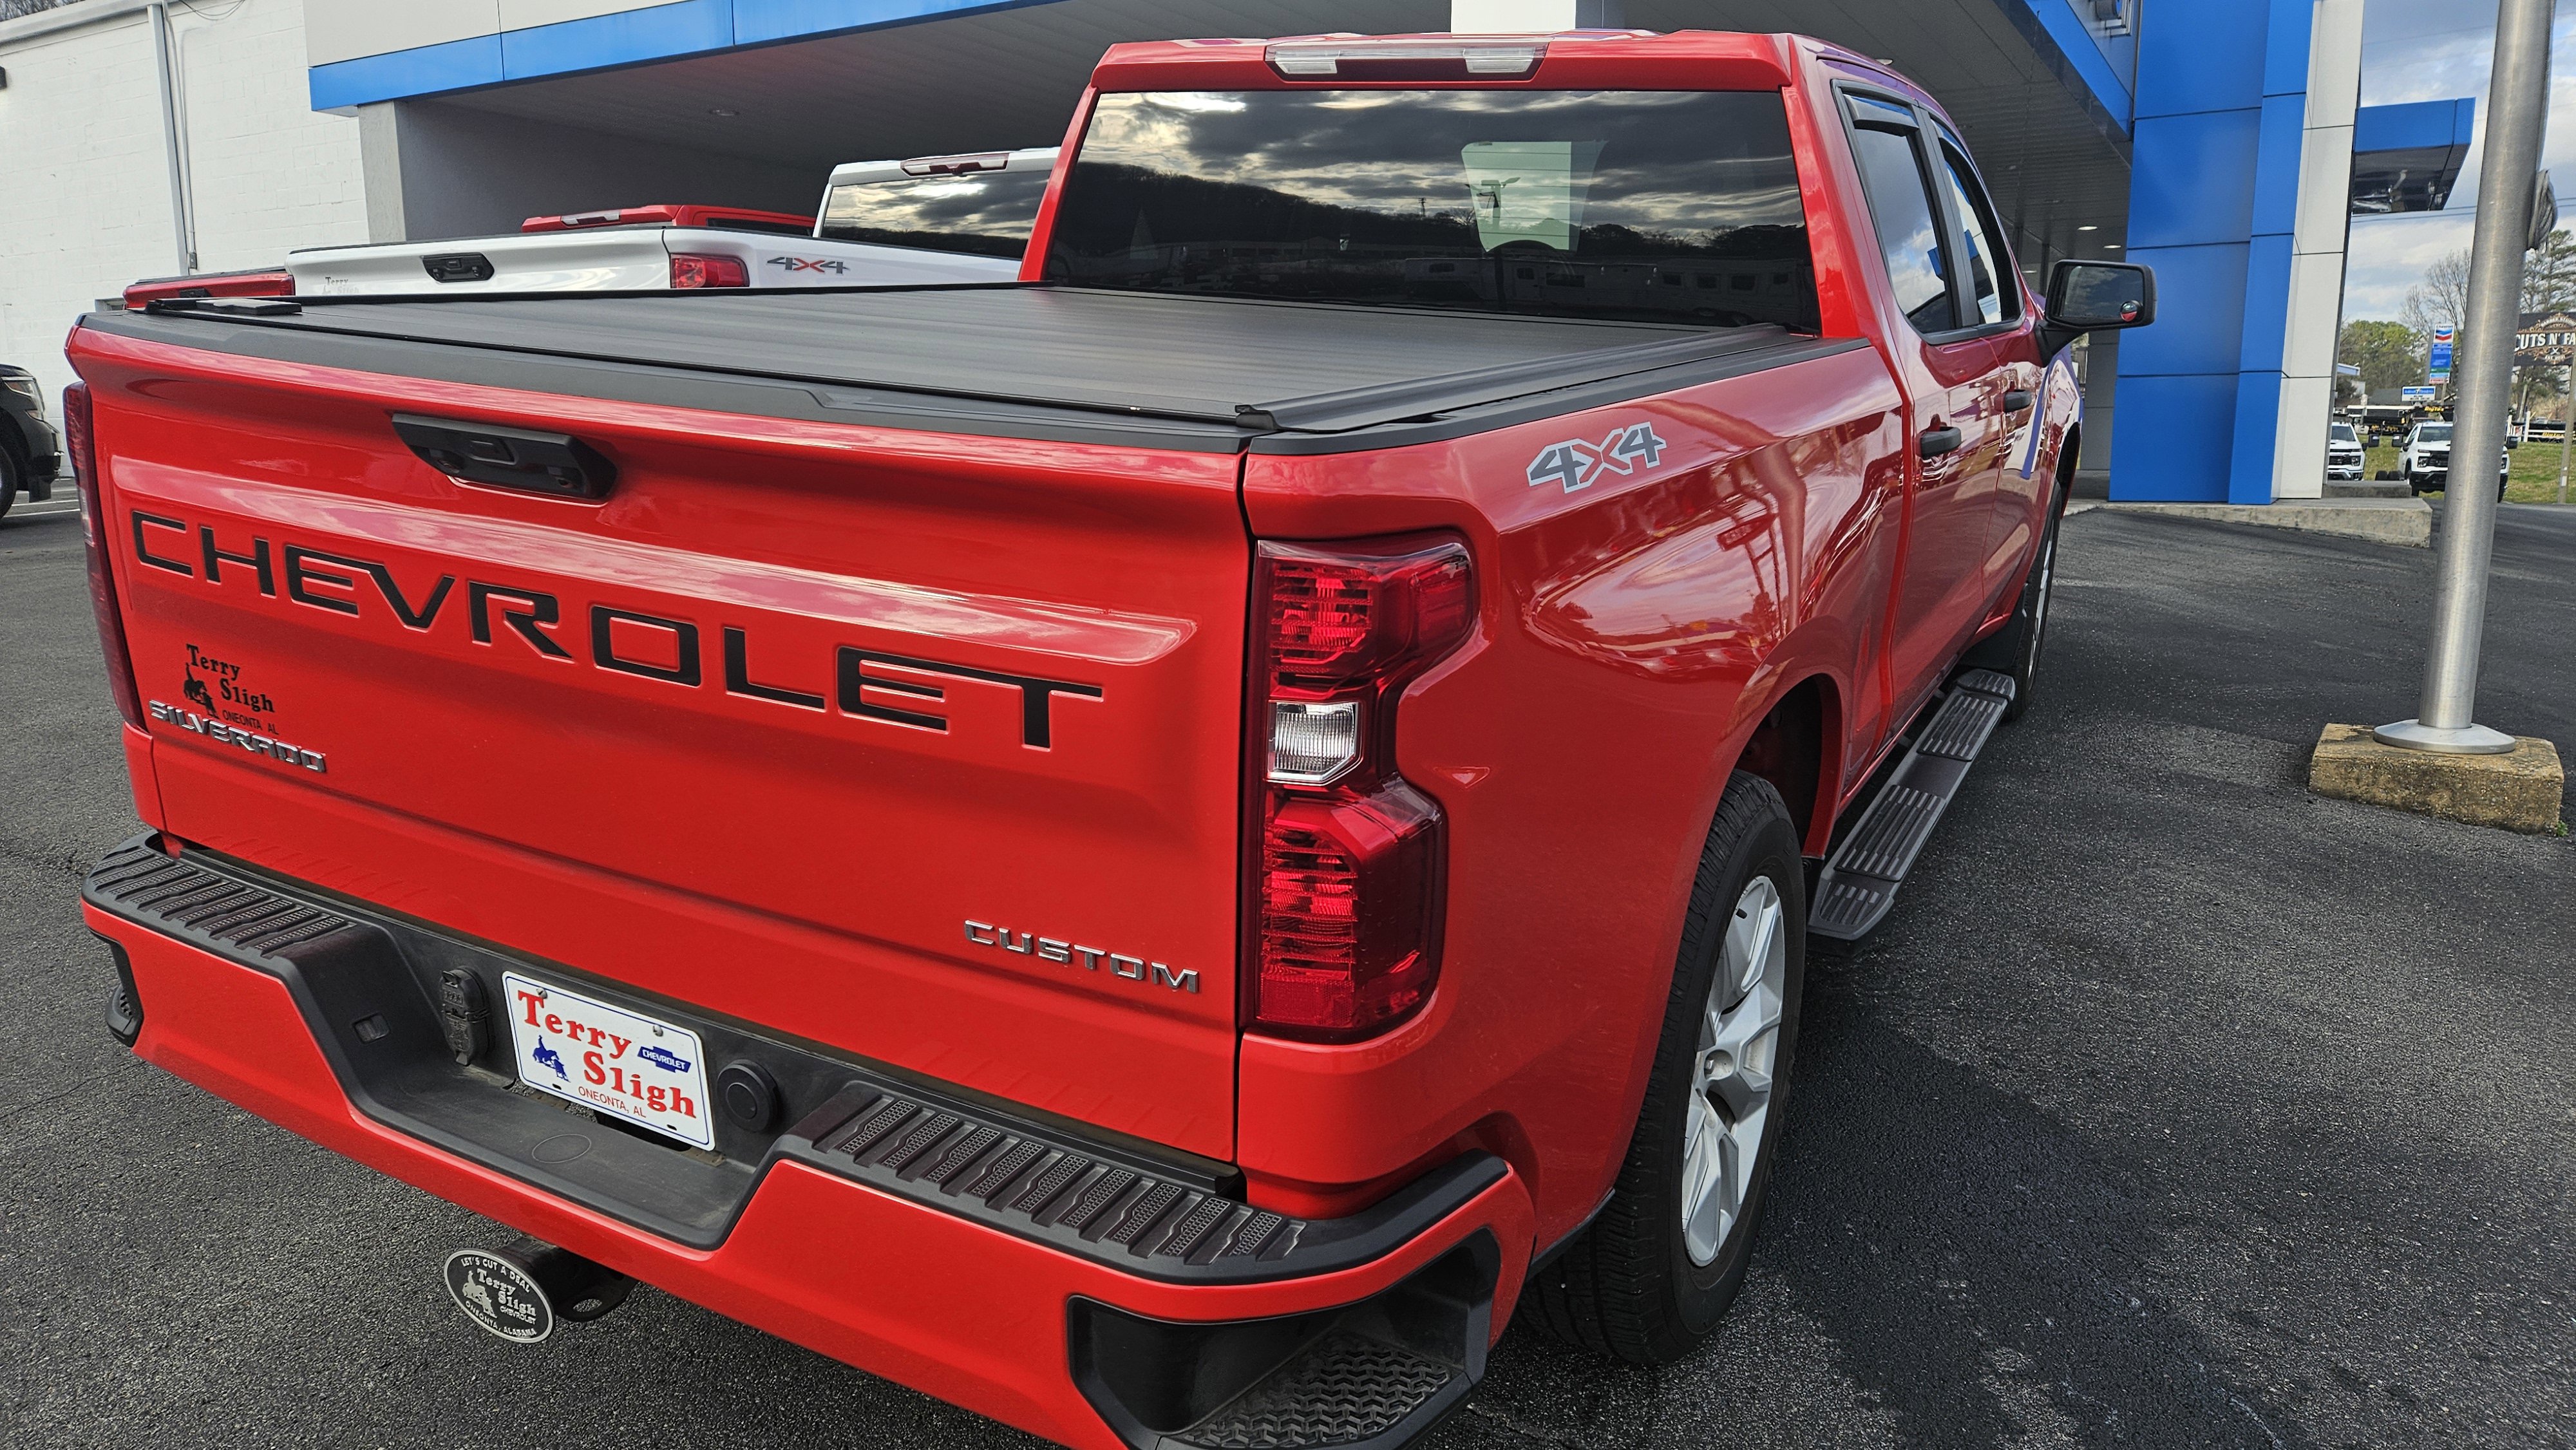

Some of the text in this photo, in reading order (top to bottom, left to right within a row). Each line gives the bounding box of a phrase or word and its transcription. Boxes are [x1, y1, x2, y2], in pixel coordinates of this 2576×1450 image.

[325, 277, 348, 287] Terry
[131, 511, 1104, 752] CHEVROLET
[186, 643, 241, 681] Terry
[220, 678, 276, 713] Sligh
[149, 699, 327, 773] SILVERADO
[223, 709, 279, 735] ONEONTA AL
[964, 919, 1200, 993] CUSTOM
[518, 990, 632, 1059] Terry
[642, 1049, 686, 1071] CHEVROLET
[578, 1086, 629, 1114] ONEONTA,
[583, 1051, 697, 1119] Sligh
[460, 1257, 531, 1293] LET'S CUT A DEAL
[477, 1268, 516, 1295] Terry
[465, 1300, 537, 1337] ONEONTA, ALABAMA
[498, 1290, 536, 1317] Sligh
[500, 1306, 536, 1325] CHEVROLET
